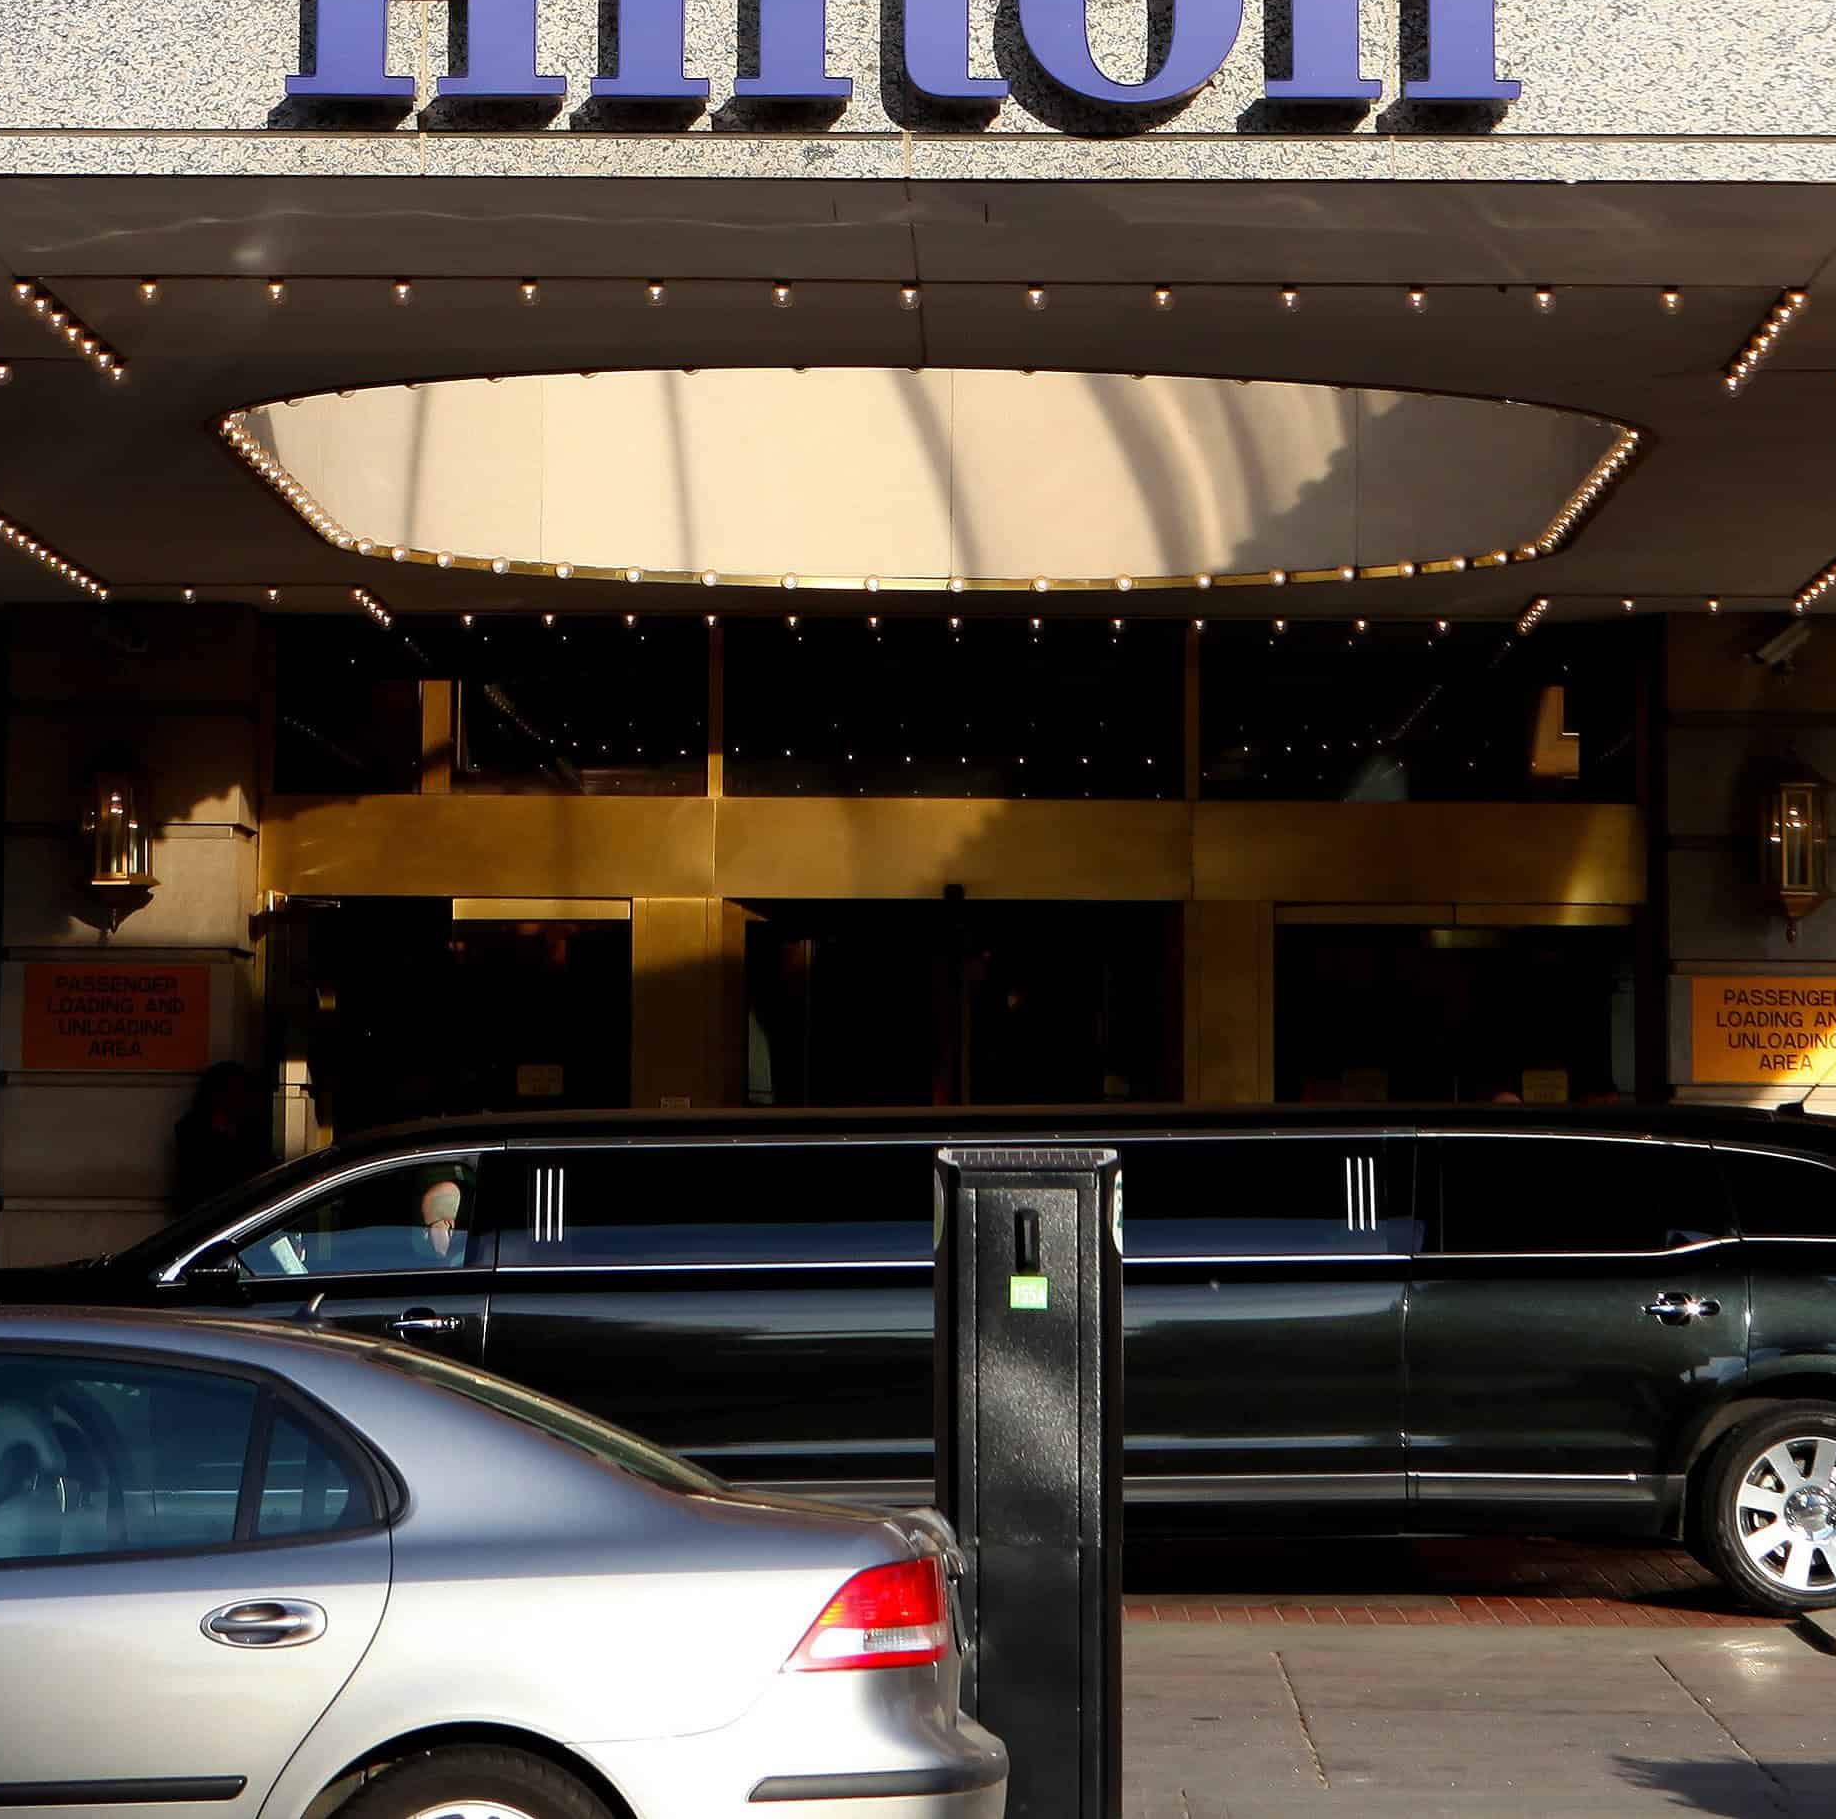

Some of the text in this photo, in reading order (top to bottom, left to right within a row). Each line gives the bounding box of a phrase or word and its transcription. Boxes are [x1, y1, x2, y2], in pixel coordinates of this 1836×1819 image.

[54, 975, 179, 992] PASSENGER
[46, 996, 186, 1014] LOADING AND
[58, 1019, 173, 1037] UNLOADING
[1715, 1011, 1803, 1028] LOADING
[87, 1041, 144, 1058] AREA
[1758, 1054, 1813, 1071] AREA
